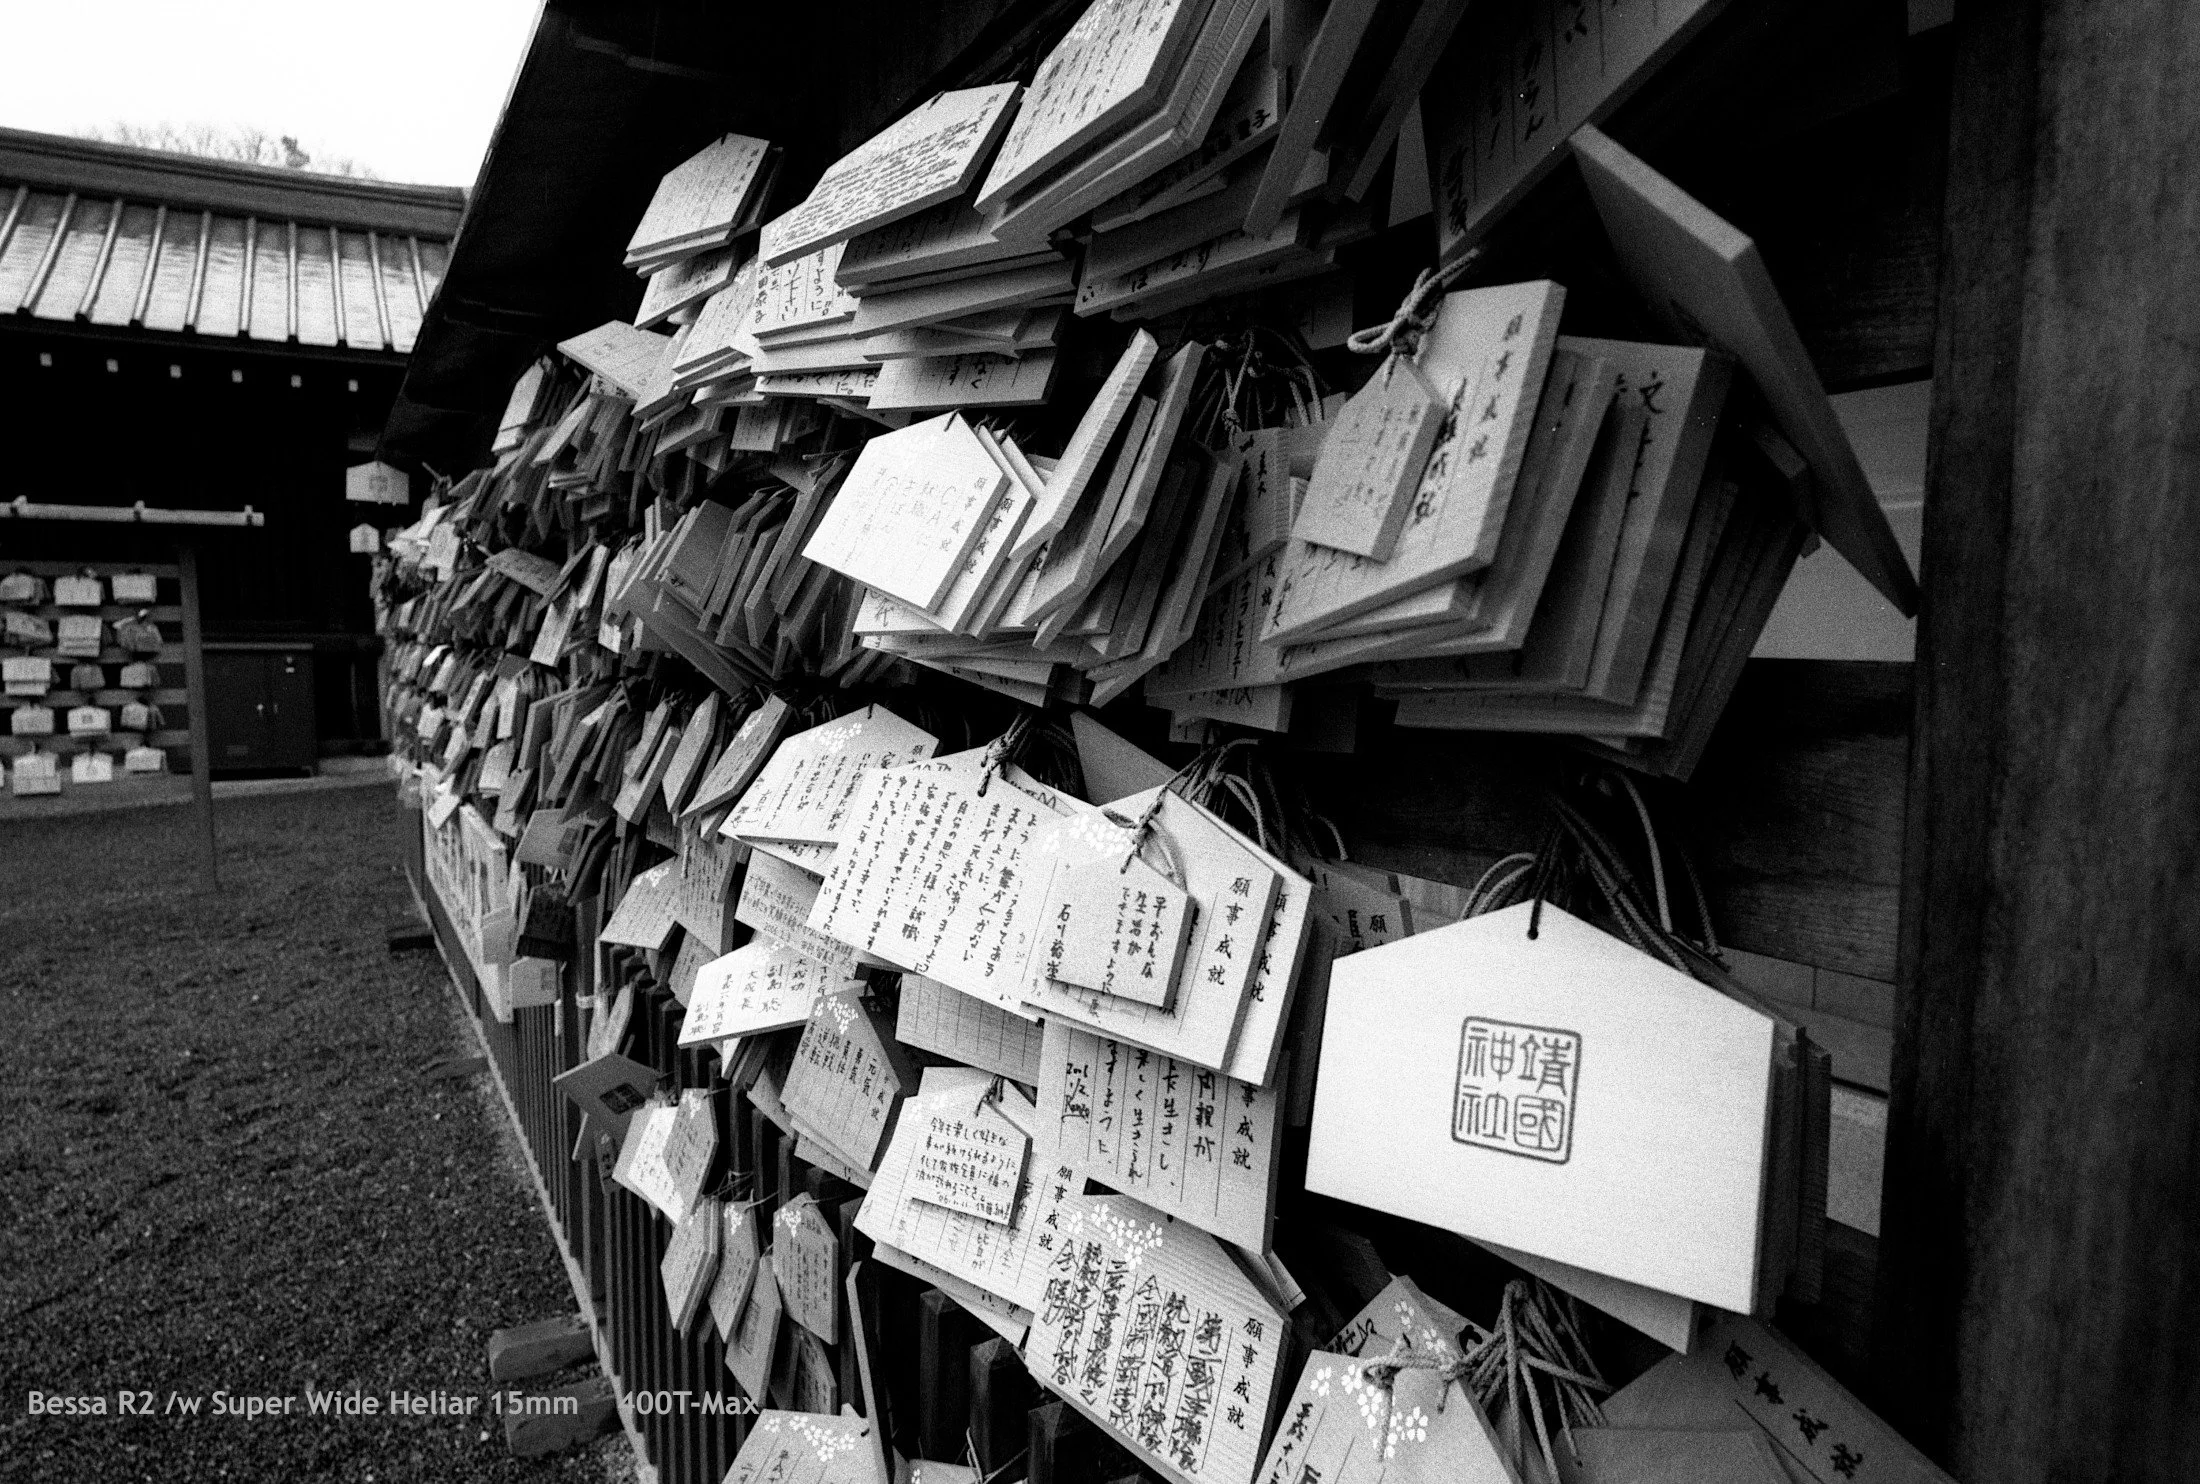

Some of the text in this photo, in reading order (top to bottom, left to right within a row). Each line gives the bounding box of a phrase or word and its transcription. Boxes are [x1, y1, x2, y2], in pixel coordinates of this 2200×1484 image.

[1208, 877, 1253, 986] 願事成就
[1039, 1165, 1072, 1251] 願事成就
[1227, 1317, 1265, 1431] 願事成就
